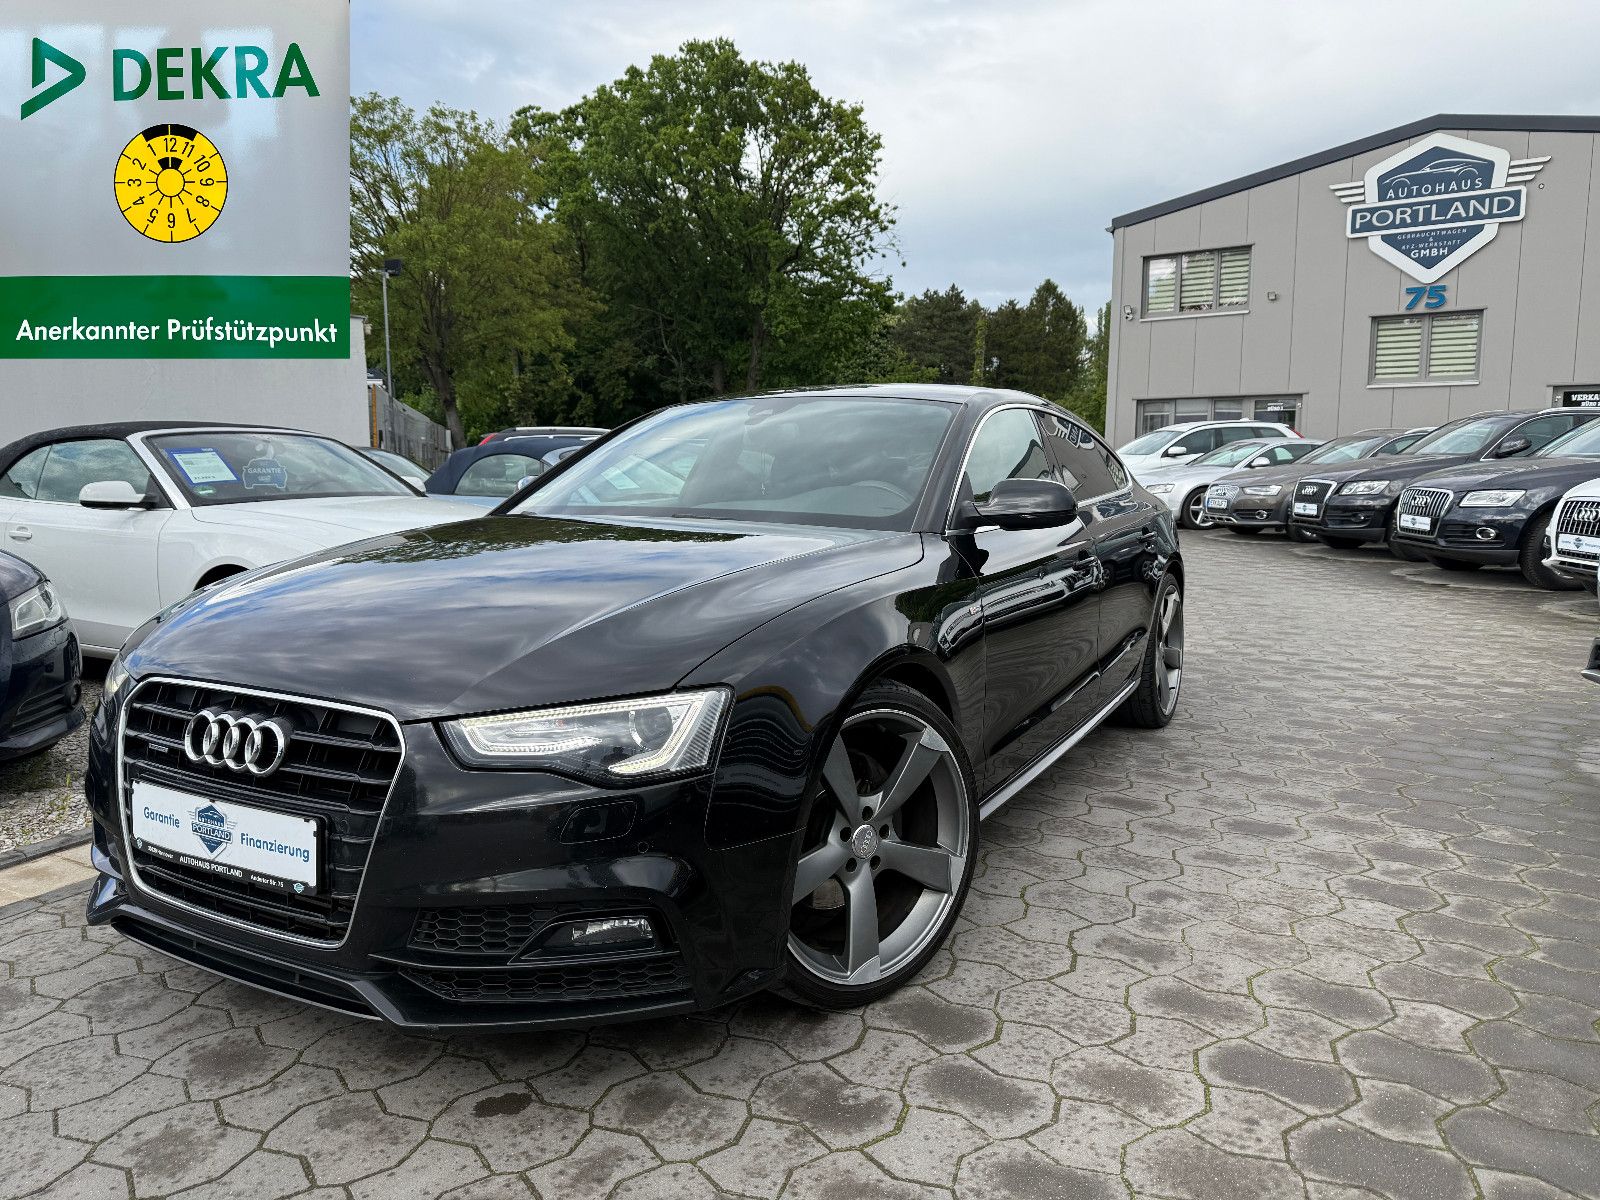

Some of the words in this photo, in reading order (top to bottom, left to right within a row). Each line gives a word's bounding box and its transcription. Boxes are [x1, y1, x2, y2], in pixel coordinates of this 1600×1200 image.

[1386, 177, 1483, 200] AUTOHAUS
[1355, 196, 1515, 229] PORTLAND
[1397, 228, 1467, 240] GEBRAUCHTWAGEN
[1411, 247, 1448, 258] GMBH
[1405, 285, 1448, 311] 75
[143, 807, 180, 828] Garantie
[192, 824, 231, 840] PORTLAND
[240, 832, 310, 862] Finanzierung
[180, 855, 210, 870] AUTOHAUS
[211, 864, 243, 878] PORTLAND
